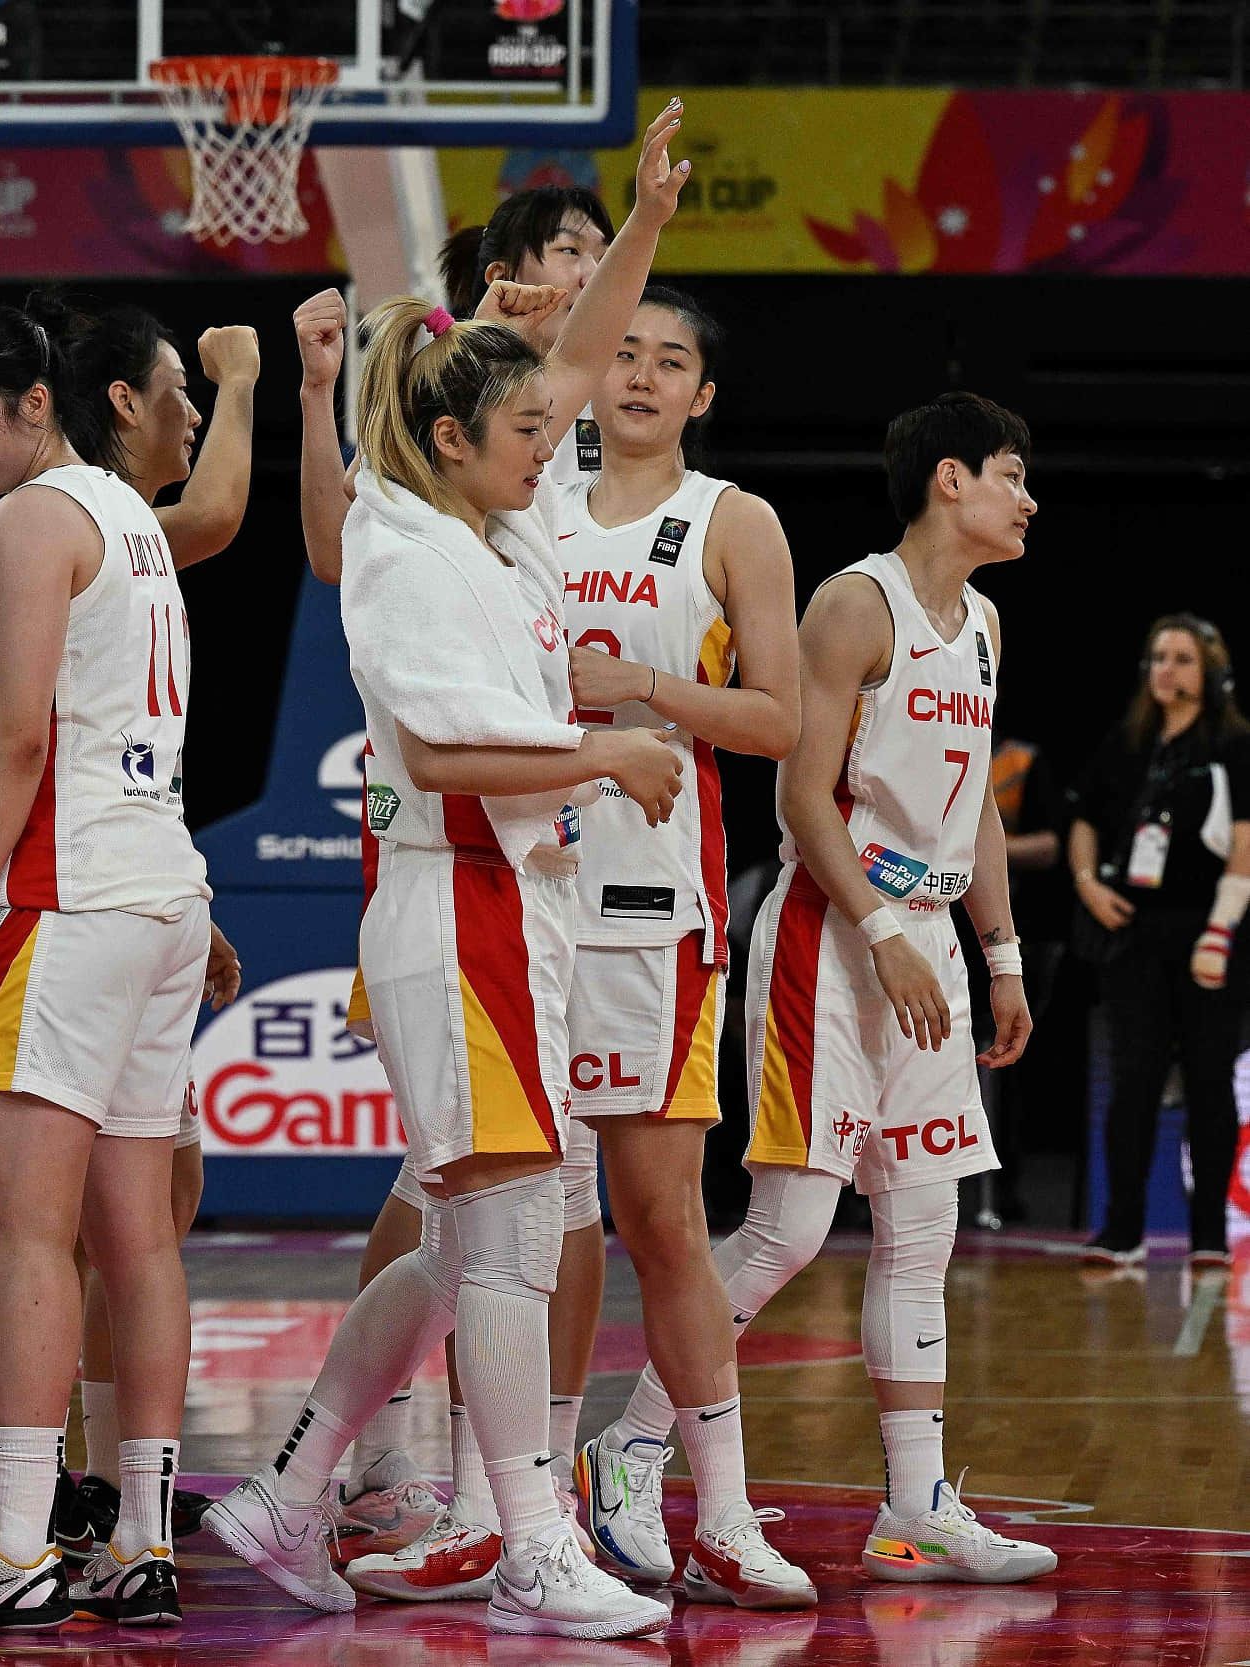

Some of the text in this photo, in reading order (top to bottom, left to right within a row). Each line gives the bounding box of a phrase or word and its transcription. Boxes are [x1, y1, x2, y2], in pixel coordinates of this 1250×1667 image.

[562, 570, 660, 609] HINA
[147, 603, 183, 717] 11
[906, 687, 993, 731] CHINA
[123, 785, 149, 798] luckin
[941, 748, 971, 826] 7
[864, 849, 919, 884] UnionPay
[568, 1052, 641, 1091] CL
[203, 1062, 409, 1147] Gan
[881, 1114, 979, 1161] TCL
